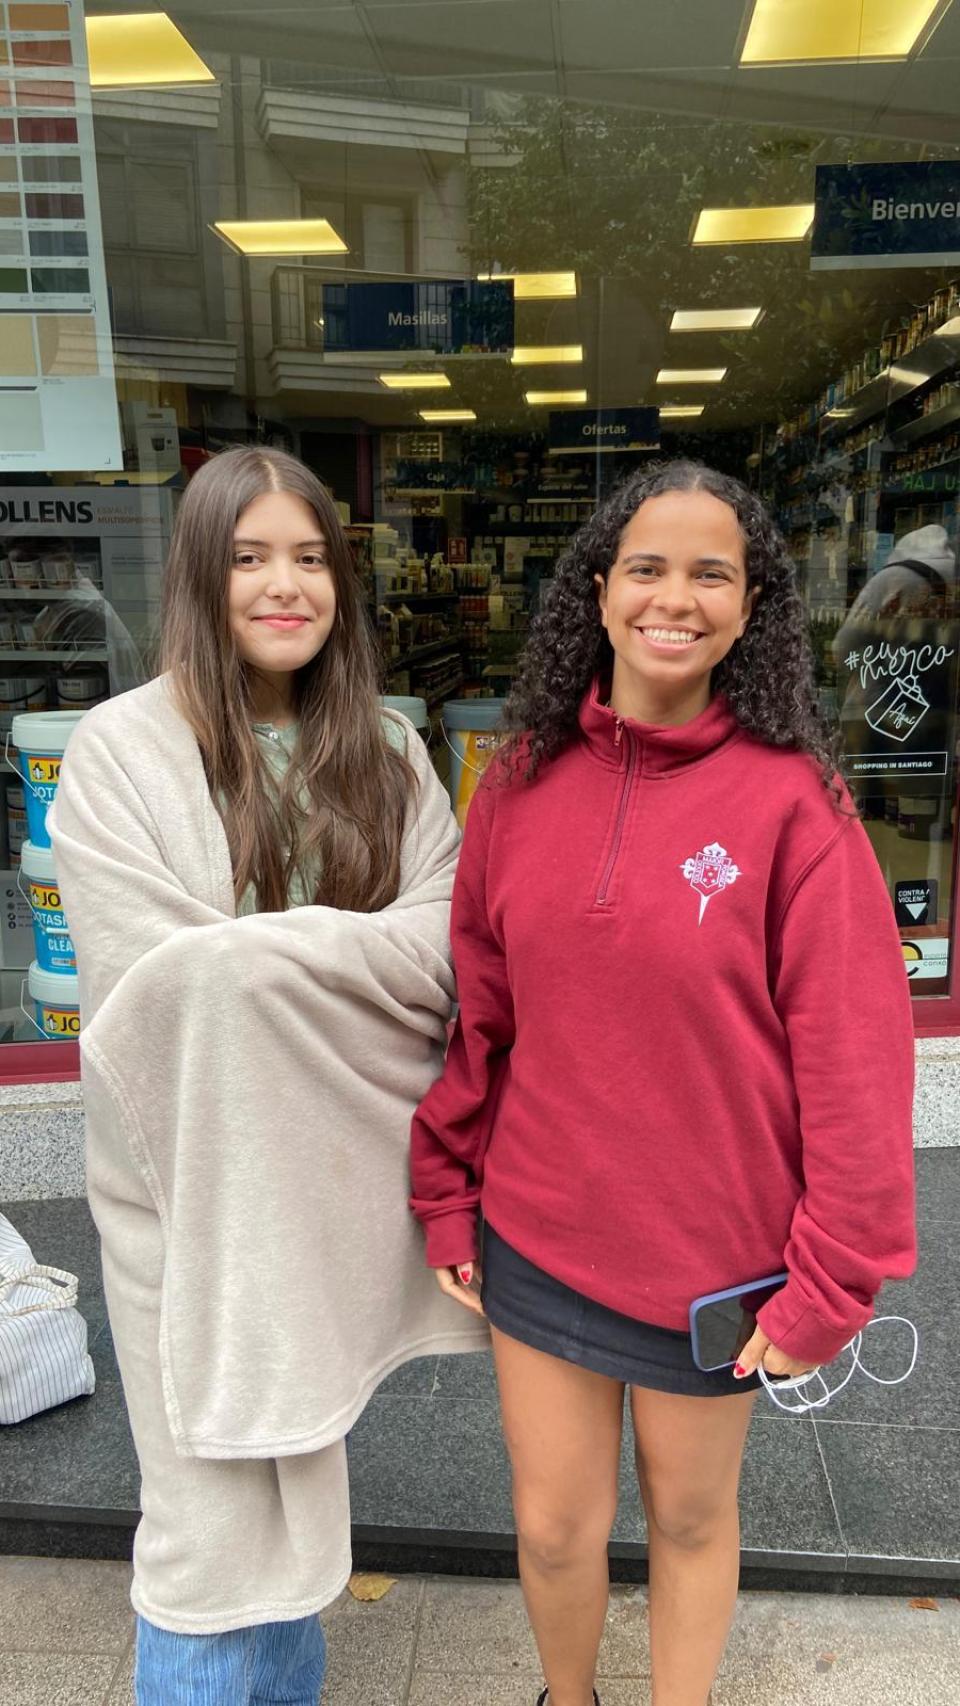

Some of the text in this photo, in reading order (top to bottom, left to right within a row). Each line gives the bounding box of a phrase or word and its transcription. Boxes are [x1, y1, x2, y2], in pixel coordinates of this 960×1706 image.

[872, 198, 960, 221] Bienve
[388, 311, 448, 326] Masillas
[582, 424, 627, 436] Ofertas
[853, 762, 888, 770] SHOPPING
[898, 760, 933, 769] SANTIAGO
[898, 889, 925, 897] CONTRA
